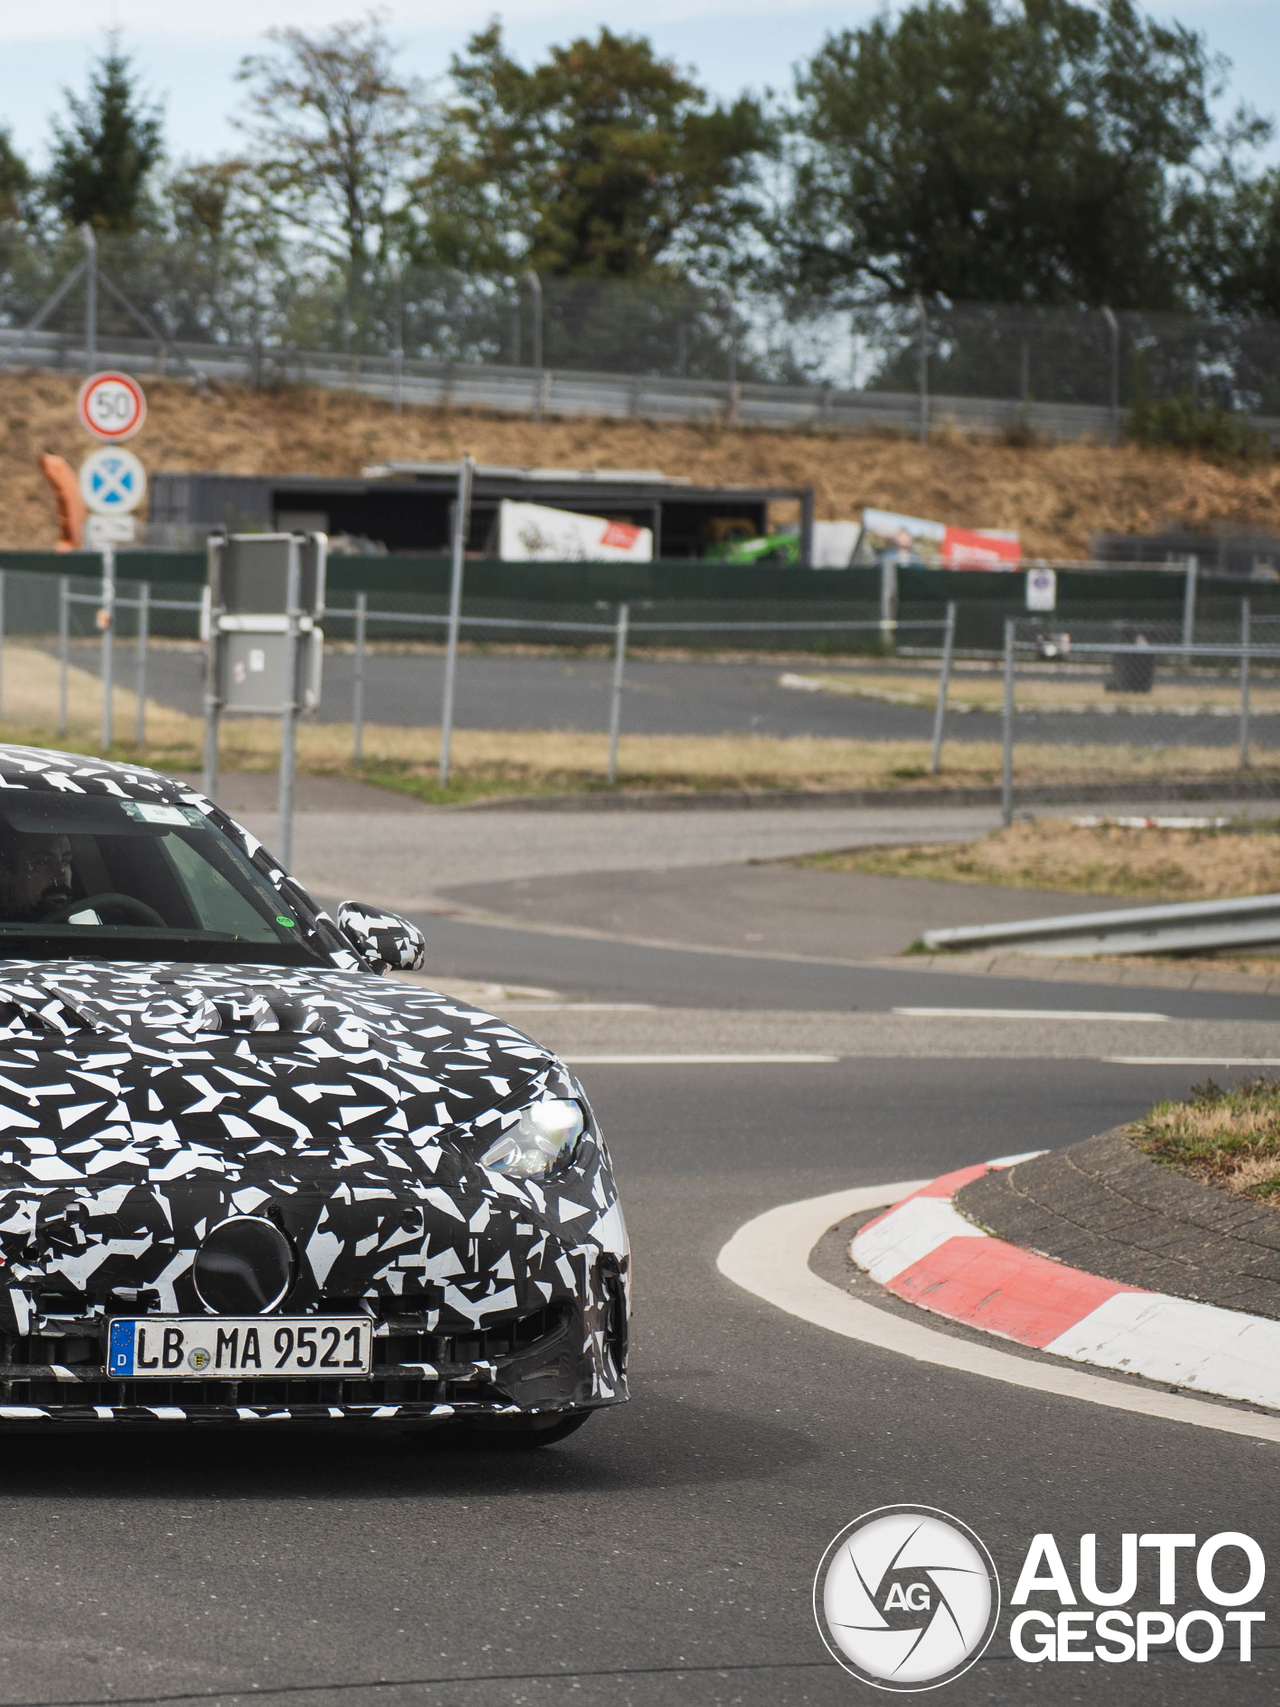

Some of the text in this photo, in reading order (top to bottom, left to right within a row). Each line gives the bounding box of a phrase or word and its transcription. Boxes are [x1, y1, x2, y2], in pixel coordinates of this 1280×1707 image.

[97, 392, 130, 419] 50
[117, 1354, 127, 1367] D
[137, 1326, 363, 1369] LB MA 9521
